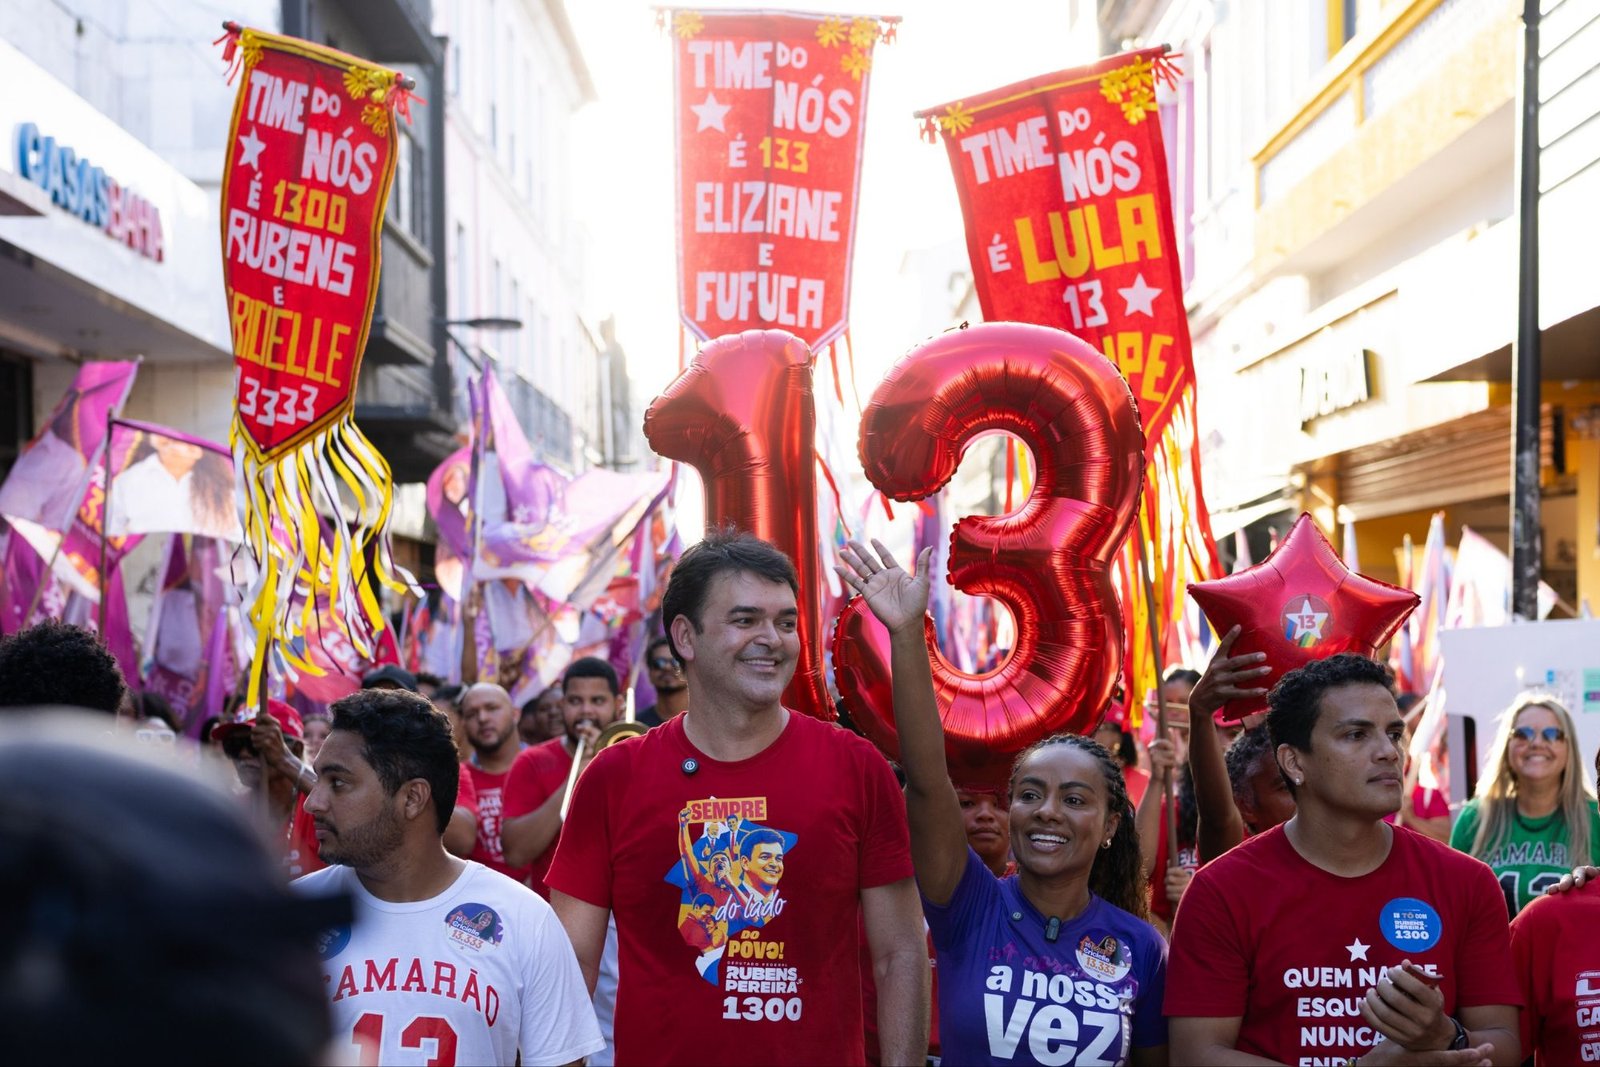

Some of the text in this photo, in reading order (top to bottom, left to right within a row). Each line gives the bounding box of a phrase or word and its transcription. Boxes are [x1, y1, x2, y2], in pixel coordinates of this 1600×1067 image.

[687, 40, 808, 89] TIME DO
[247, 69, 341, 135] TIME DO
[773, 74, 854, 138] NÓS
[301, 127, 377, 195] NÓS
[729, 133, 810, 173] É 133
[960, 107, 1091, 185] TIME DO
[1058, 131, 1141, 203] NÓS
[247, 174, 347, 235] É 1300
[695, 181, 842, 242] ELIZIANE
[226, 208, 356, 296] RUBENS
[758, 243, 774, 266] E
[987, 193, 1162, 284] É LULA
[273, 286, 284, 305] E
[695, 271, 825, 329] FUFUCA
[1062, 279, 1109, 330] 13
[1298, 614, 1316, 629] 13
[691, 800, 764, 820] SEMPRE
[715, 889, 787, 921] do lado
[728, 940, 784, 960] POVO!
[741, 929, 760, 940] DO
[1395, 930, 1430, 940] 1300
[725, 980, 797, 994] PEREIRA
[726, 966, 797, 982] RUBENS
[985, 965, 1013, 993] a
[1283, 966, 1353, 989] QUEM
[323, 957, 500, 1028] AMARÃO
[722, 996, 802, 1022] 1300
[1297, 996, 1368, 1018] ESQU
